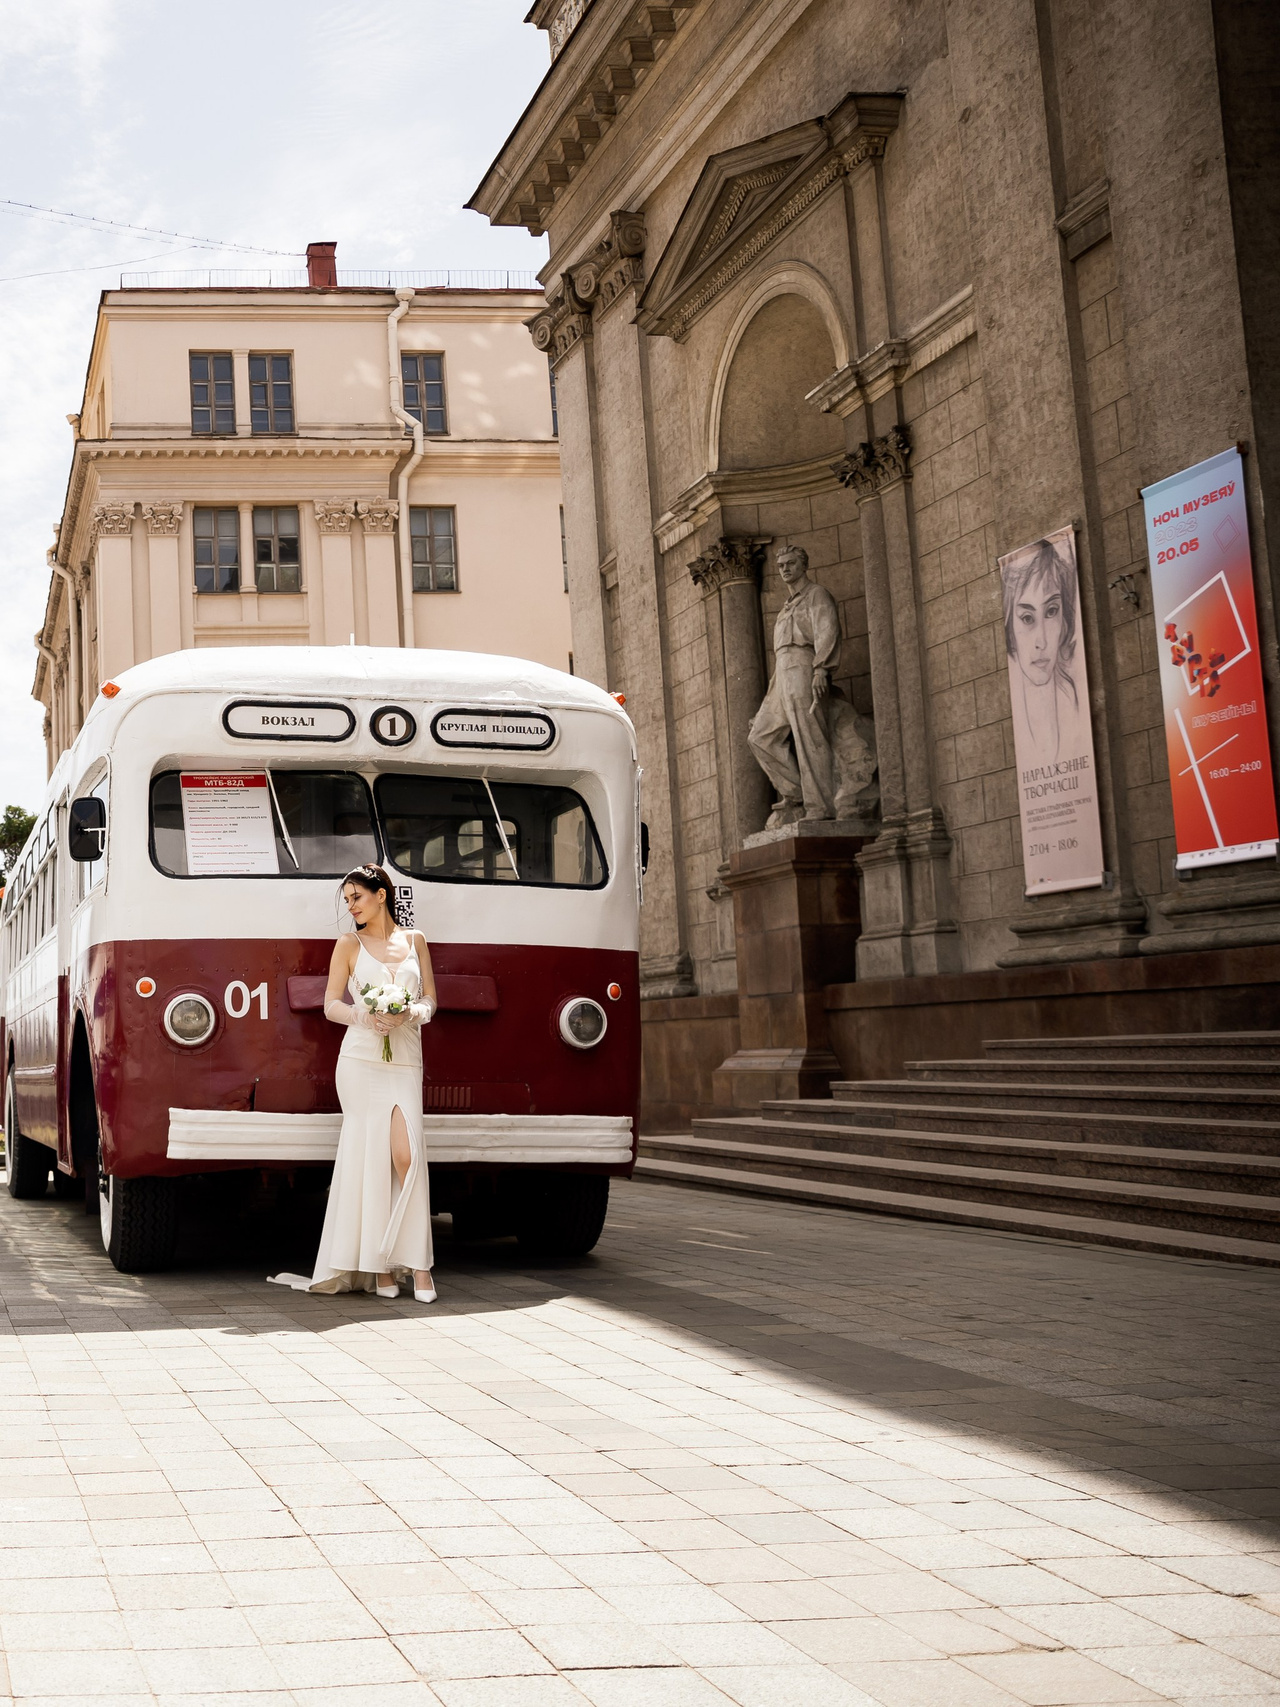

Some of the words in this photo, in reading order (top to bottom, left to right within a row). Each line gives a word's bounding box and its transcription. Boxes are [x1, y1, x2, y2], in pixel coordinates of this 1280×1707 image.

[1153, 507, 1179, 527] НОЧ
[1183, 480, 1236, 514] МУЗЕЯЎ
[1155, 517, 1198, 546] 2023
[1157, 537, 1200, 565] 20.05
[261, 715, 315, 727] ВОКЗАЛ
[387, 716, 398, 737] 1
[1192, 700, 1257, 728] МУЗЕЙНЫ
[440, 722, 487, 733] КРУГЛАЯ
[492, 724, 547, 735] ПЛОЩАДЬ
[1022, 755, 1089, 784] НАРАДЖЭННЕ
[1209, 767, 1230, 780] 16:00
[1240, 760, 1262, 773] 24:00
[1024, 776, 1079, 800] ТВОРЧАСЦІ
[224, 980, 269, 1020] 01
